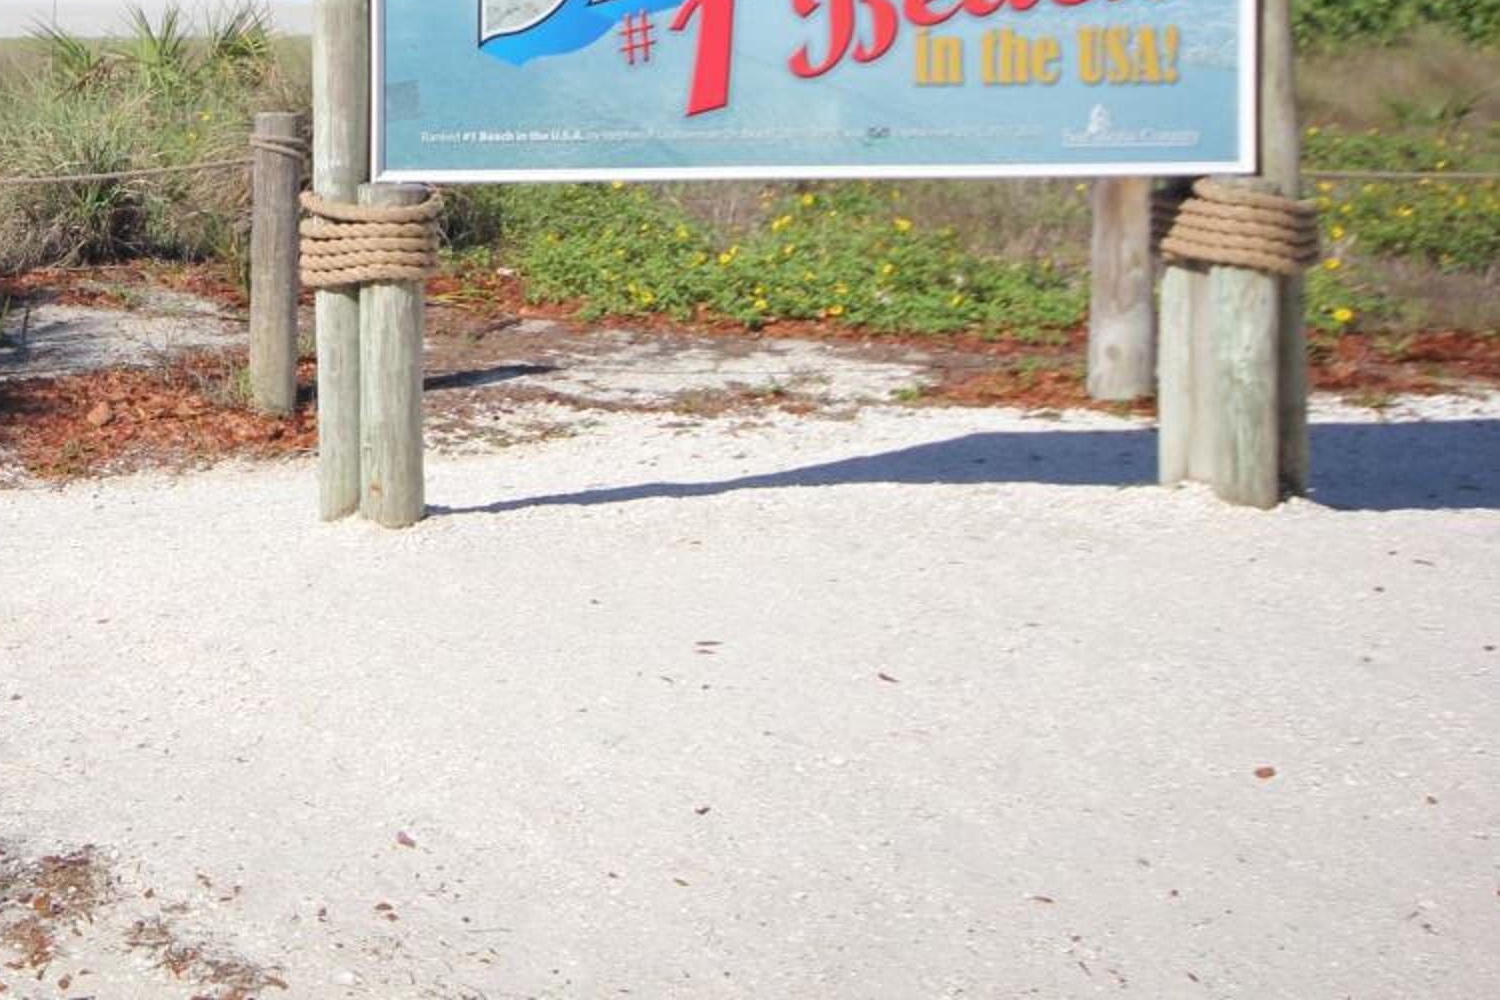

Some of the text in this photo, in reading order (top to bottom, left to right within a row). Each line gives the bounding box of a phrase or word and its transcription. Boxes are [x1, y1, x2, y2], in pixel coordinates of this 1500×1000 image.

[914, 24, 1180, 86] in the USA!
